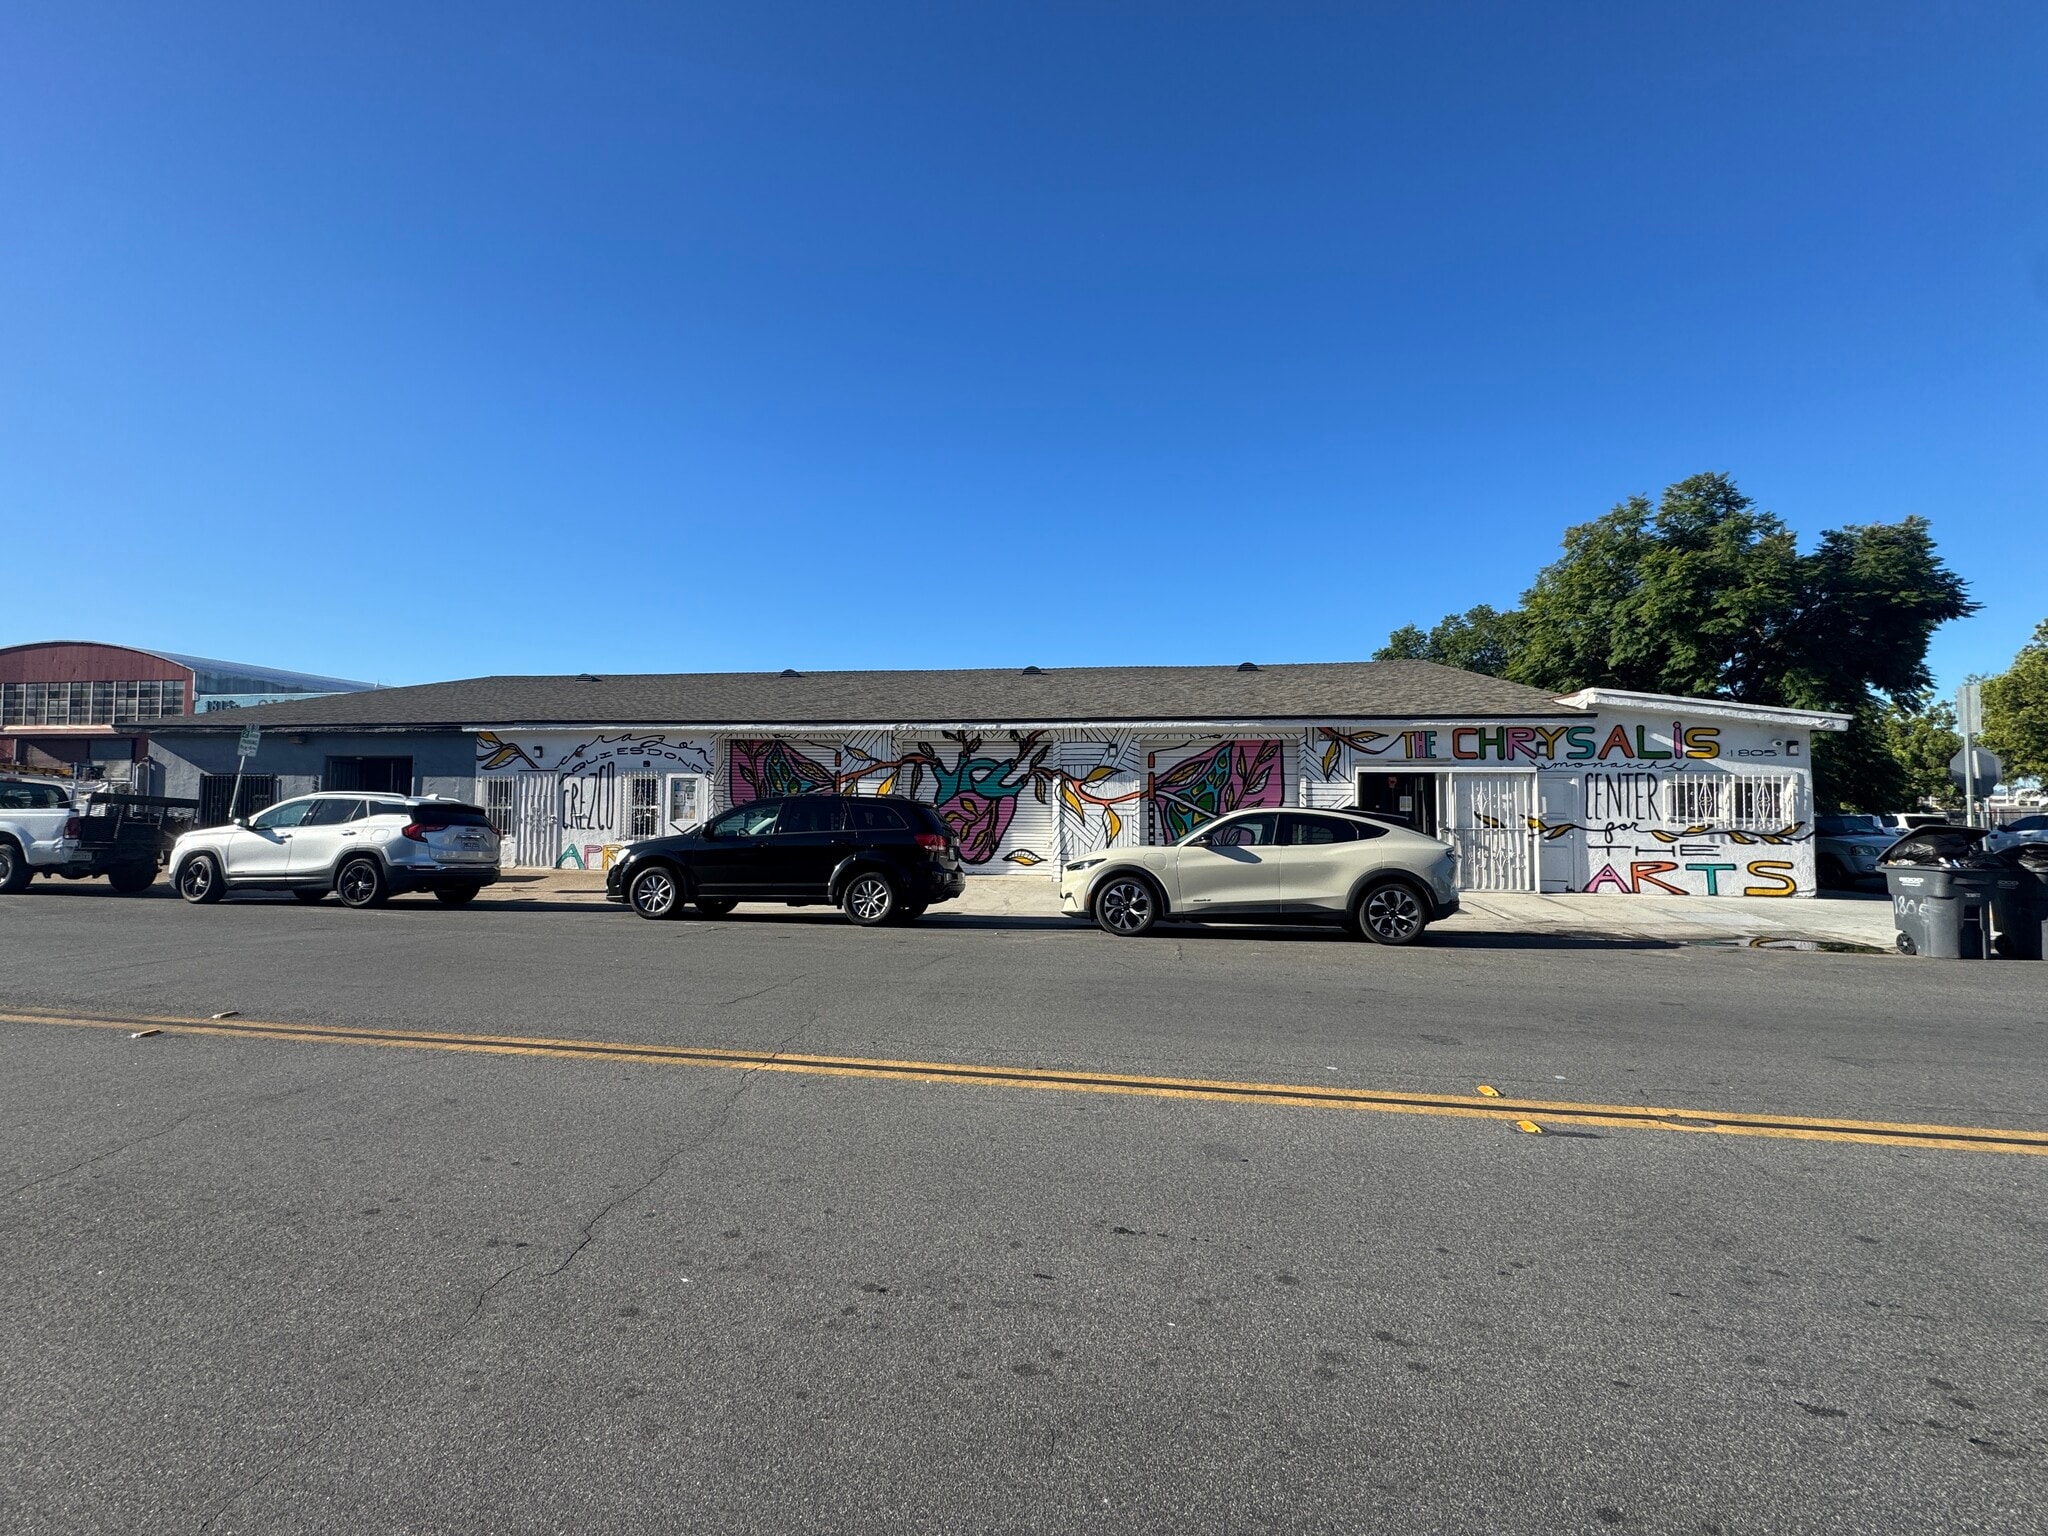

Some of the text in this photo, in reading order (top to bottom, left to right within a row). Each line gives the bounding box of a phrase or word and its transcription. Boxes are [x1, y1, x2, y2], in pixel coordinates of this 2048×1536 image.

[1402, 721, 1720, 760] THE CHRYSALIS
[562, 761, 615, 830] CREZCO
[1585, 772, 1660, 821] CENTER
[1588, 844, 1720, 857] THE
[1603, 821, 1638, 844] for
[1582, 860, 1797, 896] ARTS
